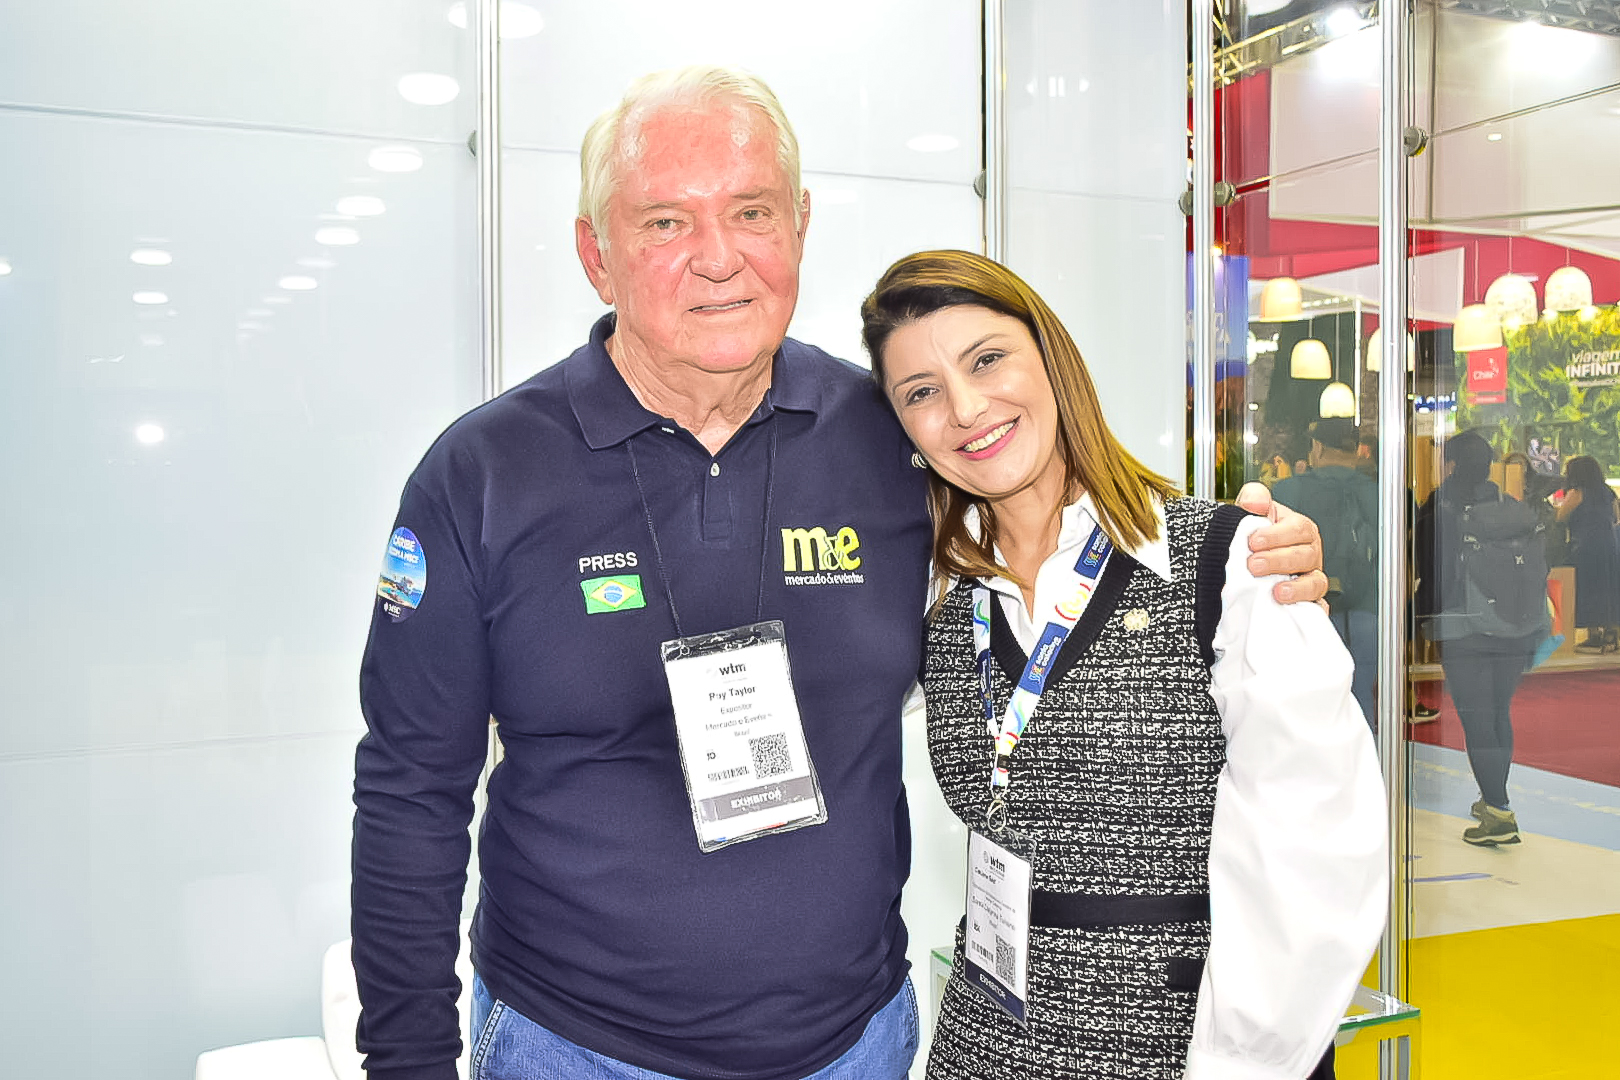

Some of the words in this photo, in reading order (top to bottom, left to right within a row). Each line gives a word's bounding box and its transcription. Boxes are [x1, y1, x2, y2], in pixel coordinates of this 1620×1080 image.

[781, 526, 861, 572] m&e
[579, 552, 638, 573] PRESS
[719, 662, 747, 676] wtm
